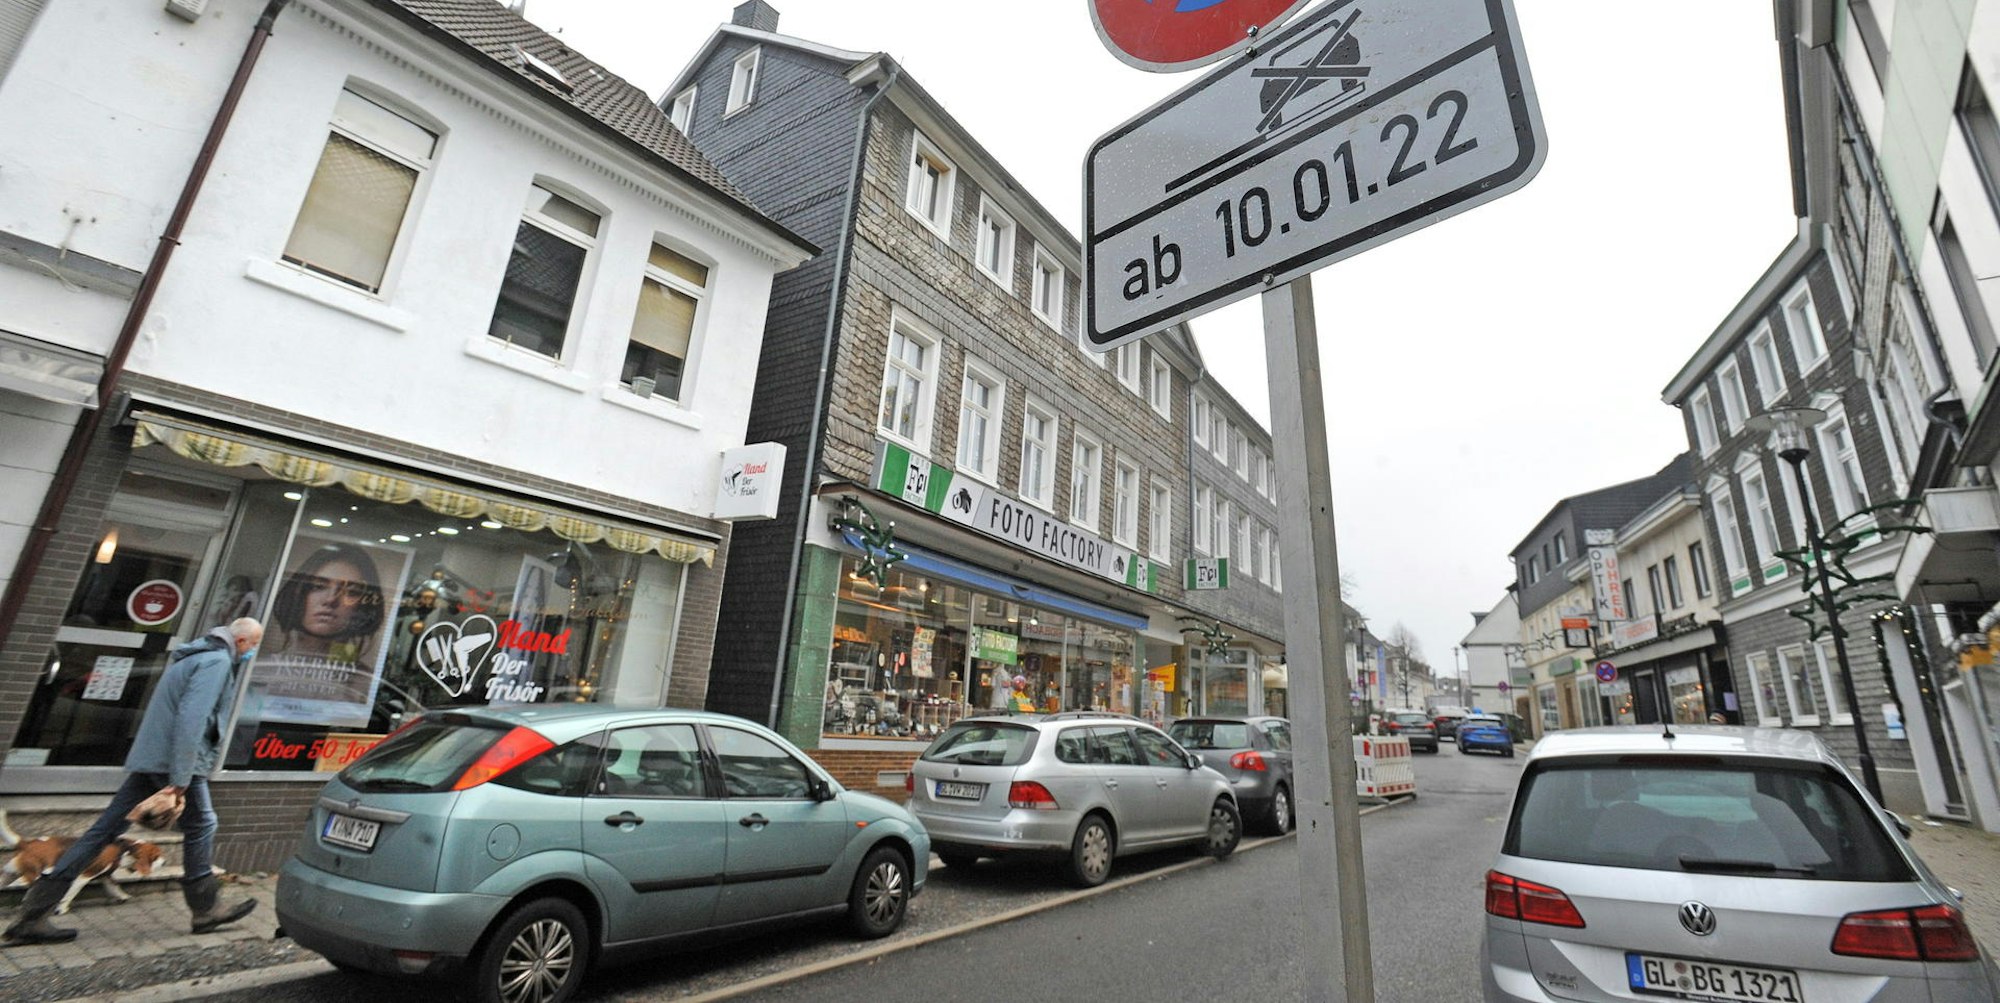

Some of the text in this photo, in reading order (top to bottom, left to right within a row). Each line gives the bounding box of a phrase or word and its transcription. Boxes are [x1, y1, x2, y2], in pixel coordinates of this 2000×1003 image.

[1122, 90, 1478, 300] ab 10.01.22
[990, 498, 1103, 569] FOTO FACTORY
[1590, 550, 1609, 609] OPTIK
[1606, 559, 1625, 618] UHREN
[491, 652, 528, 675] Der
[484, 677, 544, 702] Frisör
[254, 732, 306, 759] Über
[307, 739, 338, 759] 50
[1644, 960, 1676, 987] GL
[1692, 965, 1726, 993] BG
[1730, 969, 1798, 1003] 1321
